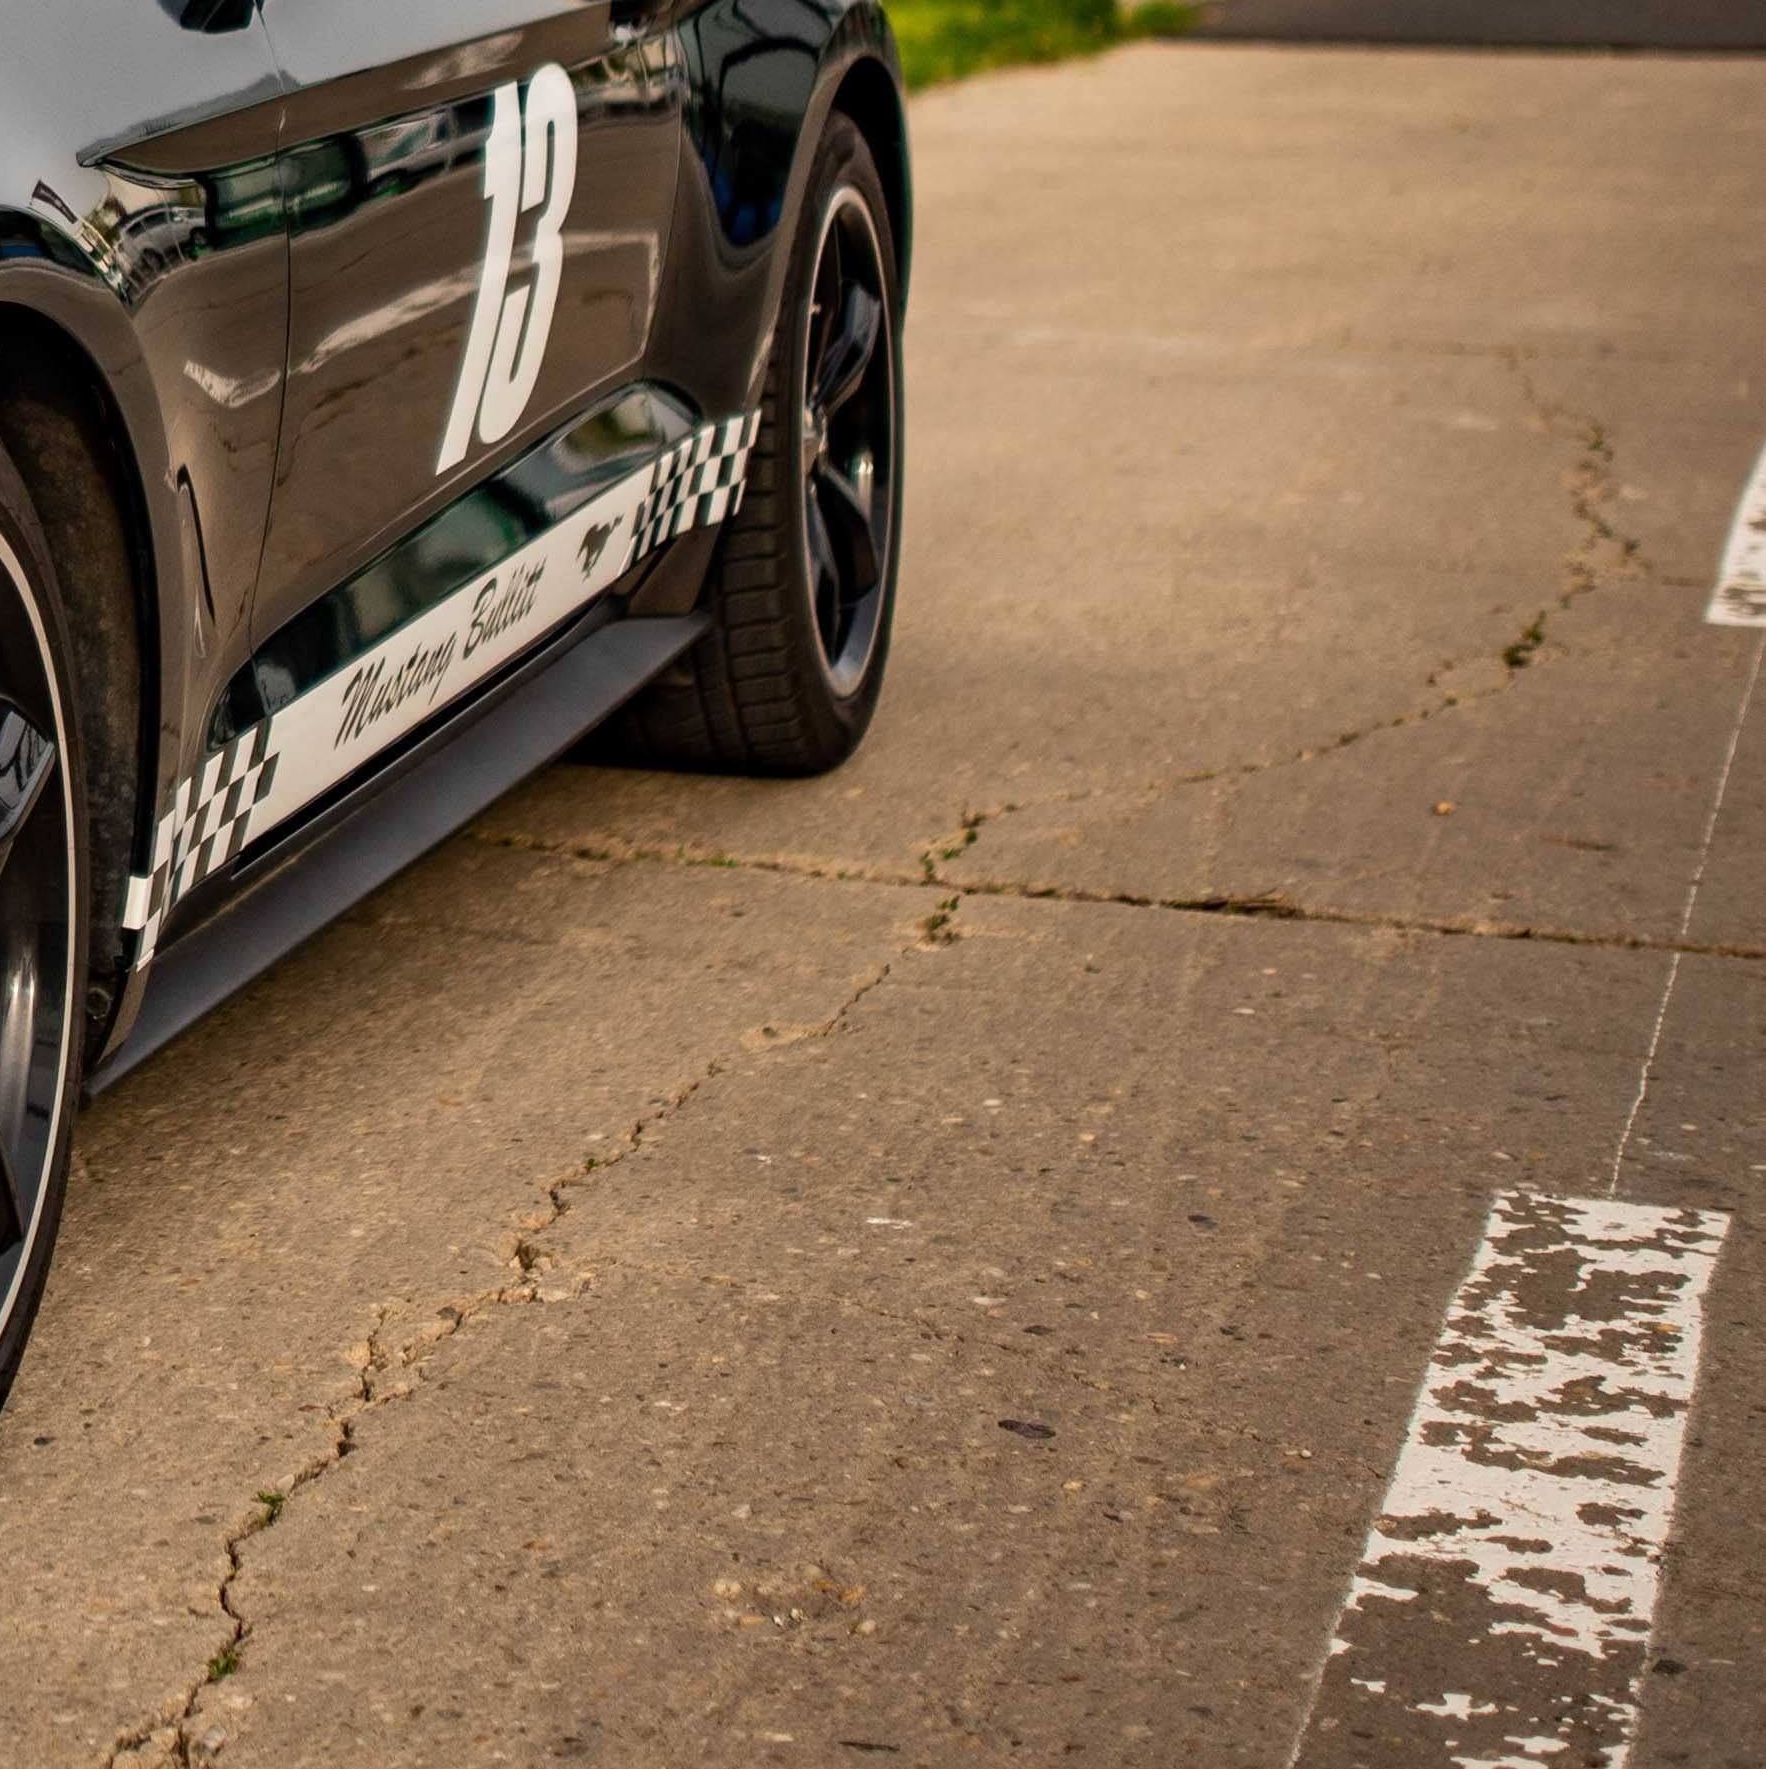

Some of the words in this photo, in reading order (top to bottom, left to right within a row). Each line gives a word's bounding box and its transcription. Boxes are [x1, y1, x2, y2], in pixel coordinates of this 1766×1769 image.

[436, 62, 579, 477] 13
[334, 632, 457, 750] Mustang
[463, 554, 548, 660] Bullitt
